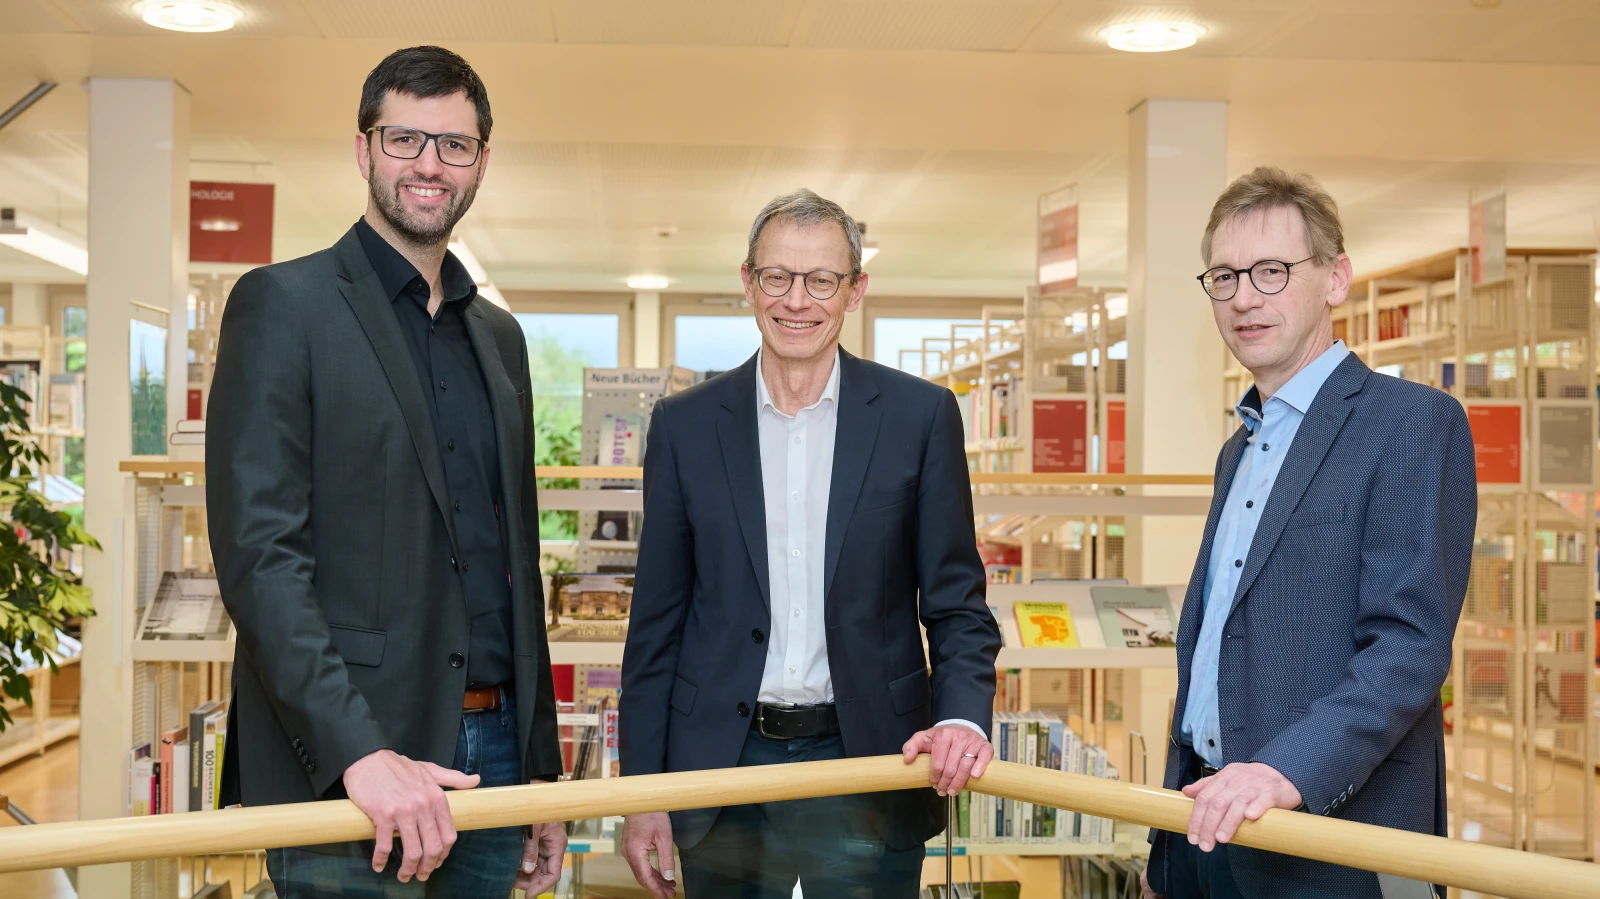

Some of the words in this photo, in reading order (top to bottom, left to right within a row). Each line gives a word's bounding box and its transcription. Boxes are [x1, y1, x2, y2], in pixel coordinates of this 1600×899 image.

[592, 373, 619, 384] Neue
[623, 372, 661, 384] Bücher
[205, 749, 215, 767] 100
